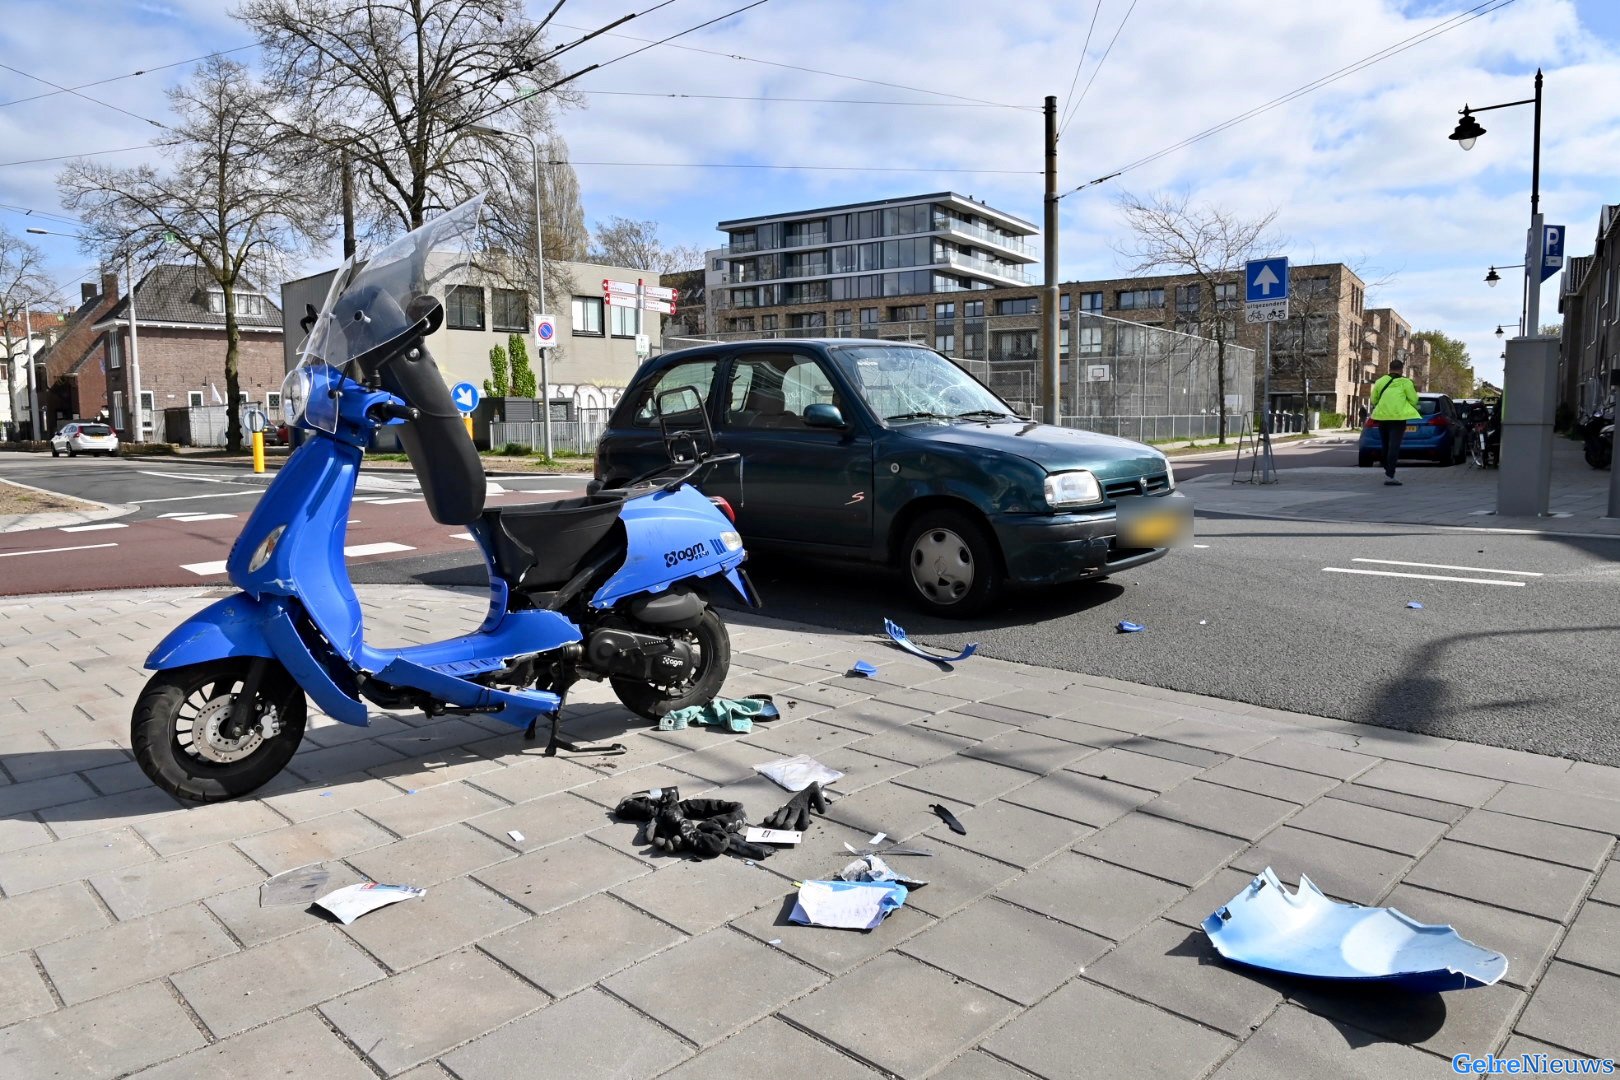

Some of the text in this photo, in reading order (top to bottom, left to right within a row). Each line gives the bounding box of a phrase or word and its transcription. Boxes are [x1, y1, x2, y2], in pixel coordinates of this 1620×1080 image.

[1546, 227, 1559, 255] P
[1246, 301, 1286, 309] uitgezonderd
[677, 543, 704, 561] agm
[669, 659, 683, 667] agm
